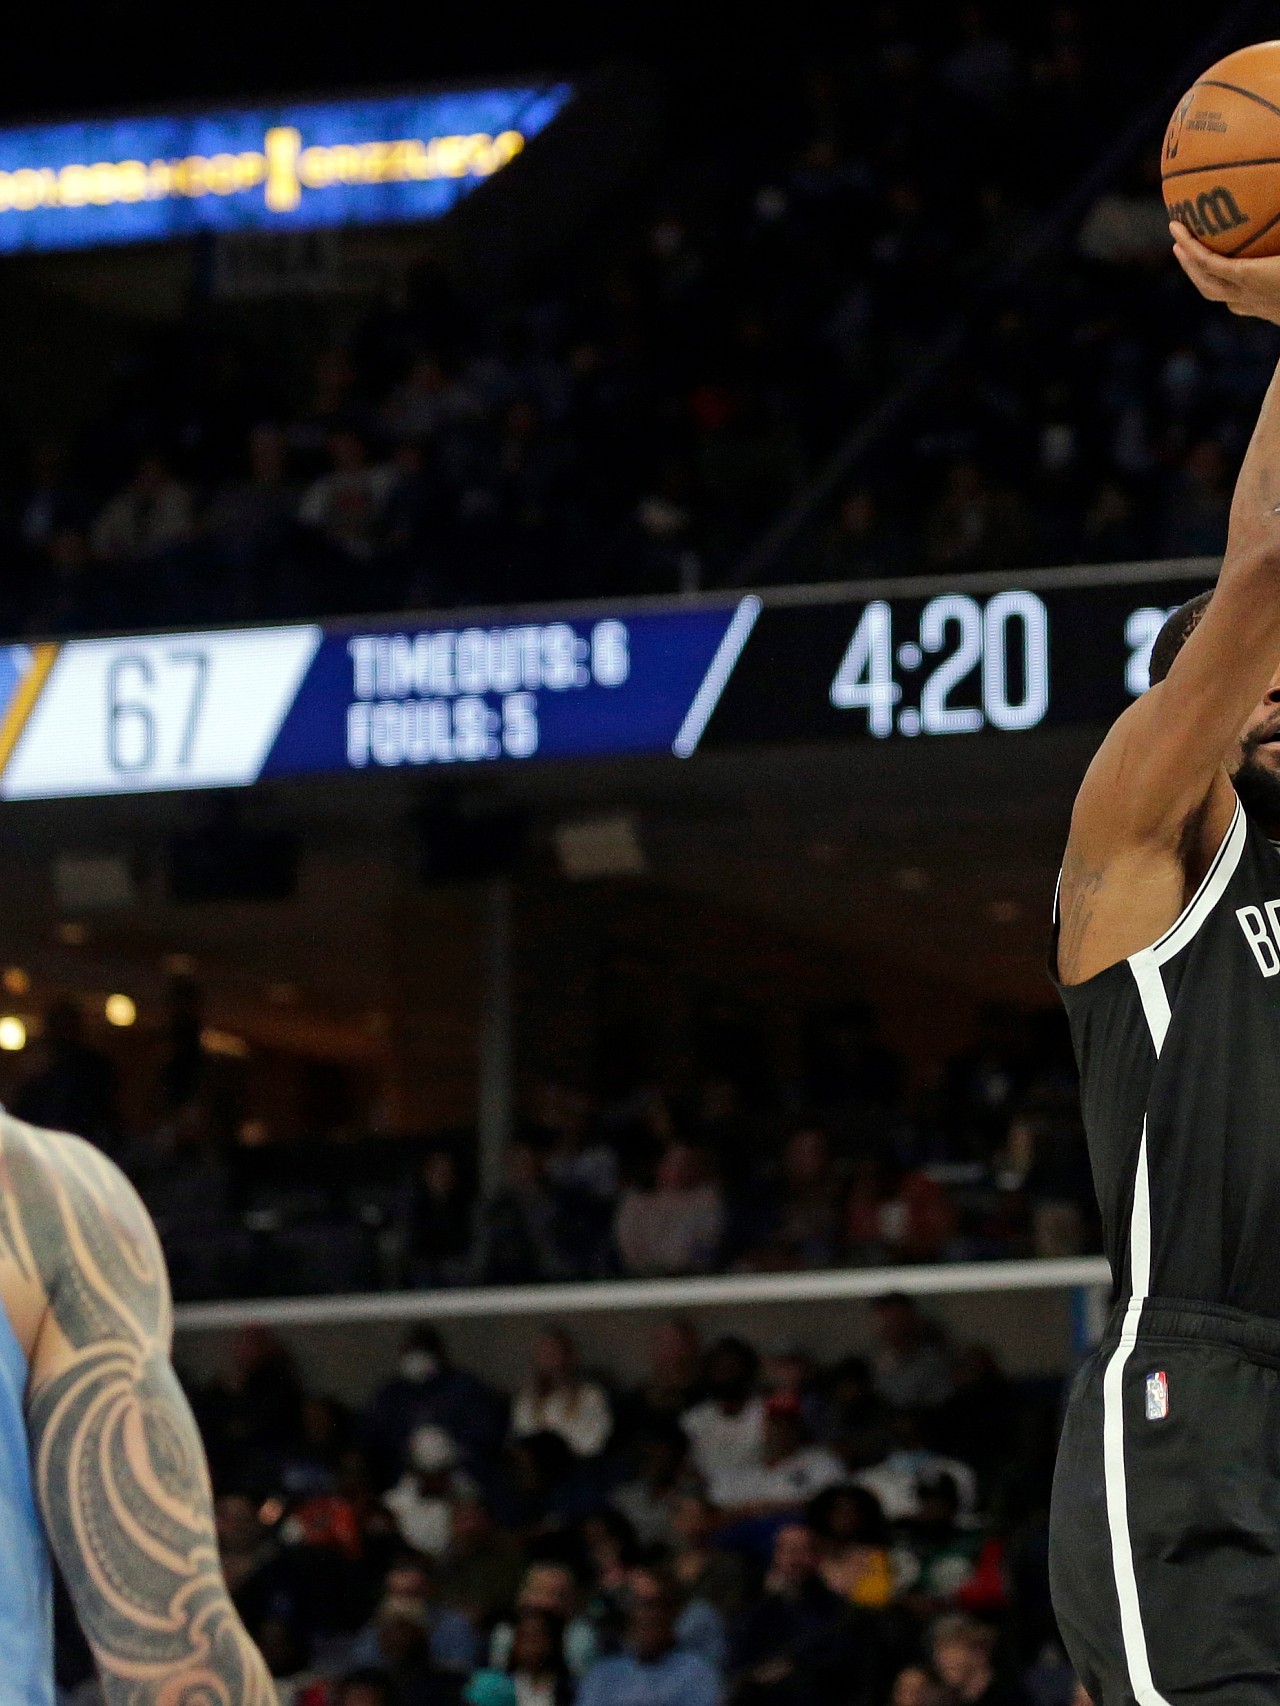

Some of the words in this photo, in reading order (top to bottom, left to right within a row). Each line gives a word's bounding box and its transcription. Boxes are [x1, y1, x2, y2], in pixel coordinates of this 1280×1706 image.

[347, 621, 591, 699] TIMEOUTS:
[590, 618, 631, 689] 6
[830, 589, 1049, 739] 4:20
[105, 648, 211, 775] 67
[347, 694, 501, 769] FOULS:
[501, 691, 540, 759] 5
